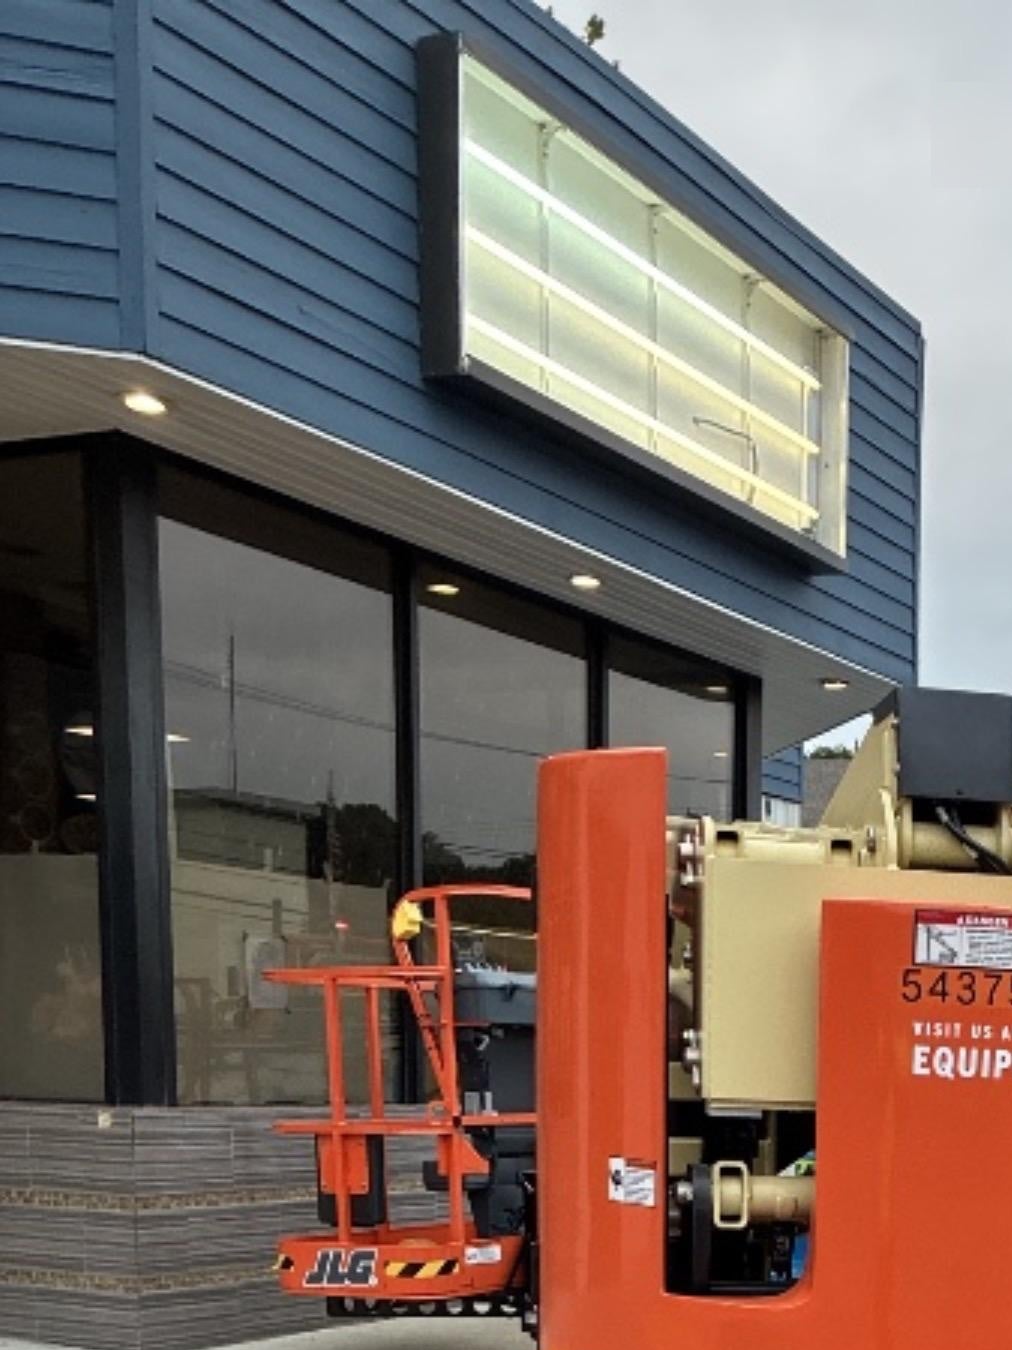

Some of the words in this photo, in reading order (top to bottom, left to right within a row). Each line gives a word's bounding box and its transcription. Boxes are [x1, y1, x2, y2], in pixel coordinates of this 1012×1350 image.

[913, 1021, 962, 1039] VISIT
[970, 1023, 993, 1039] US
[302, 1247, 379, 1288] JLG
